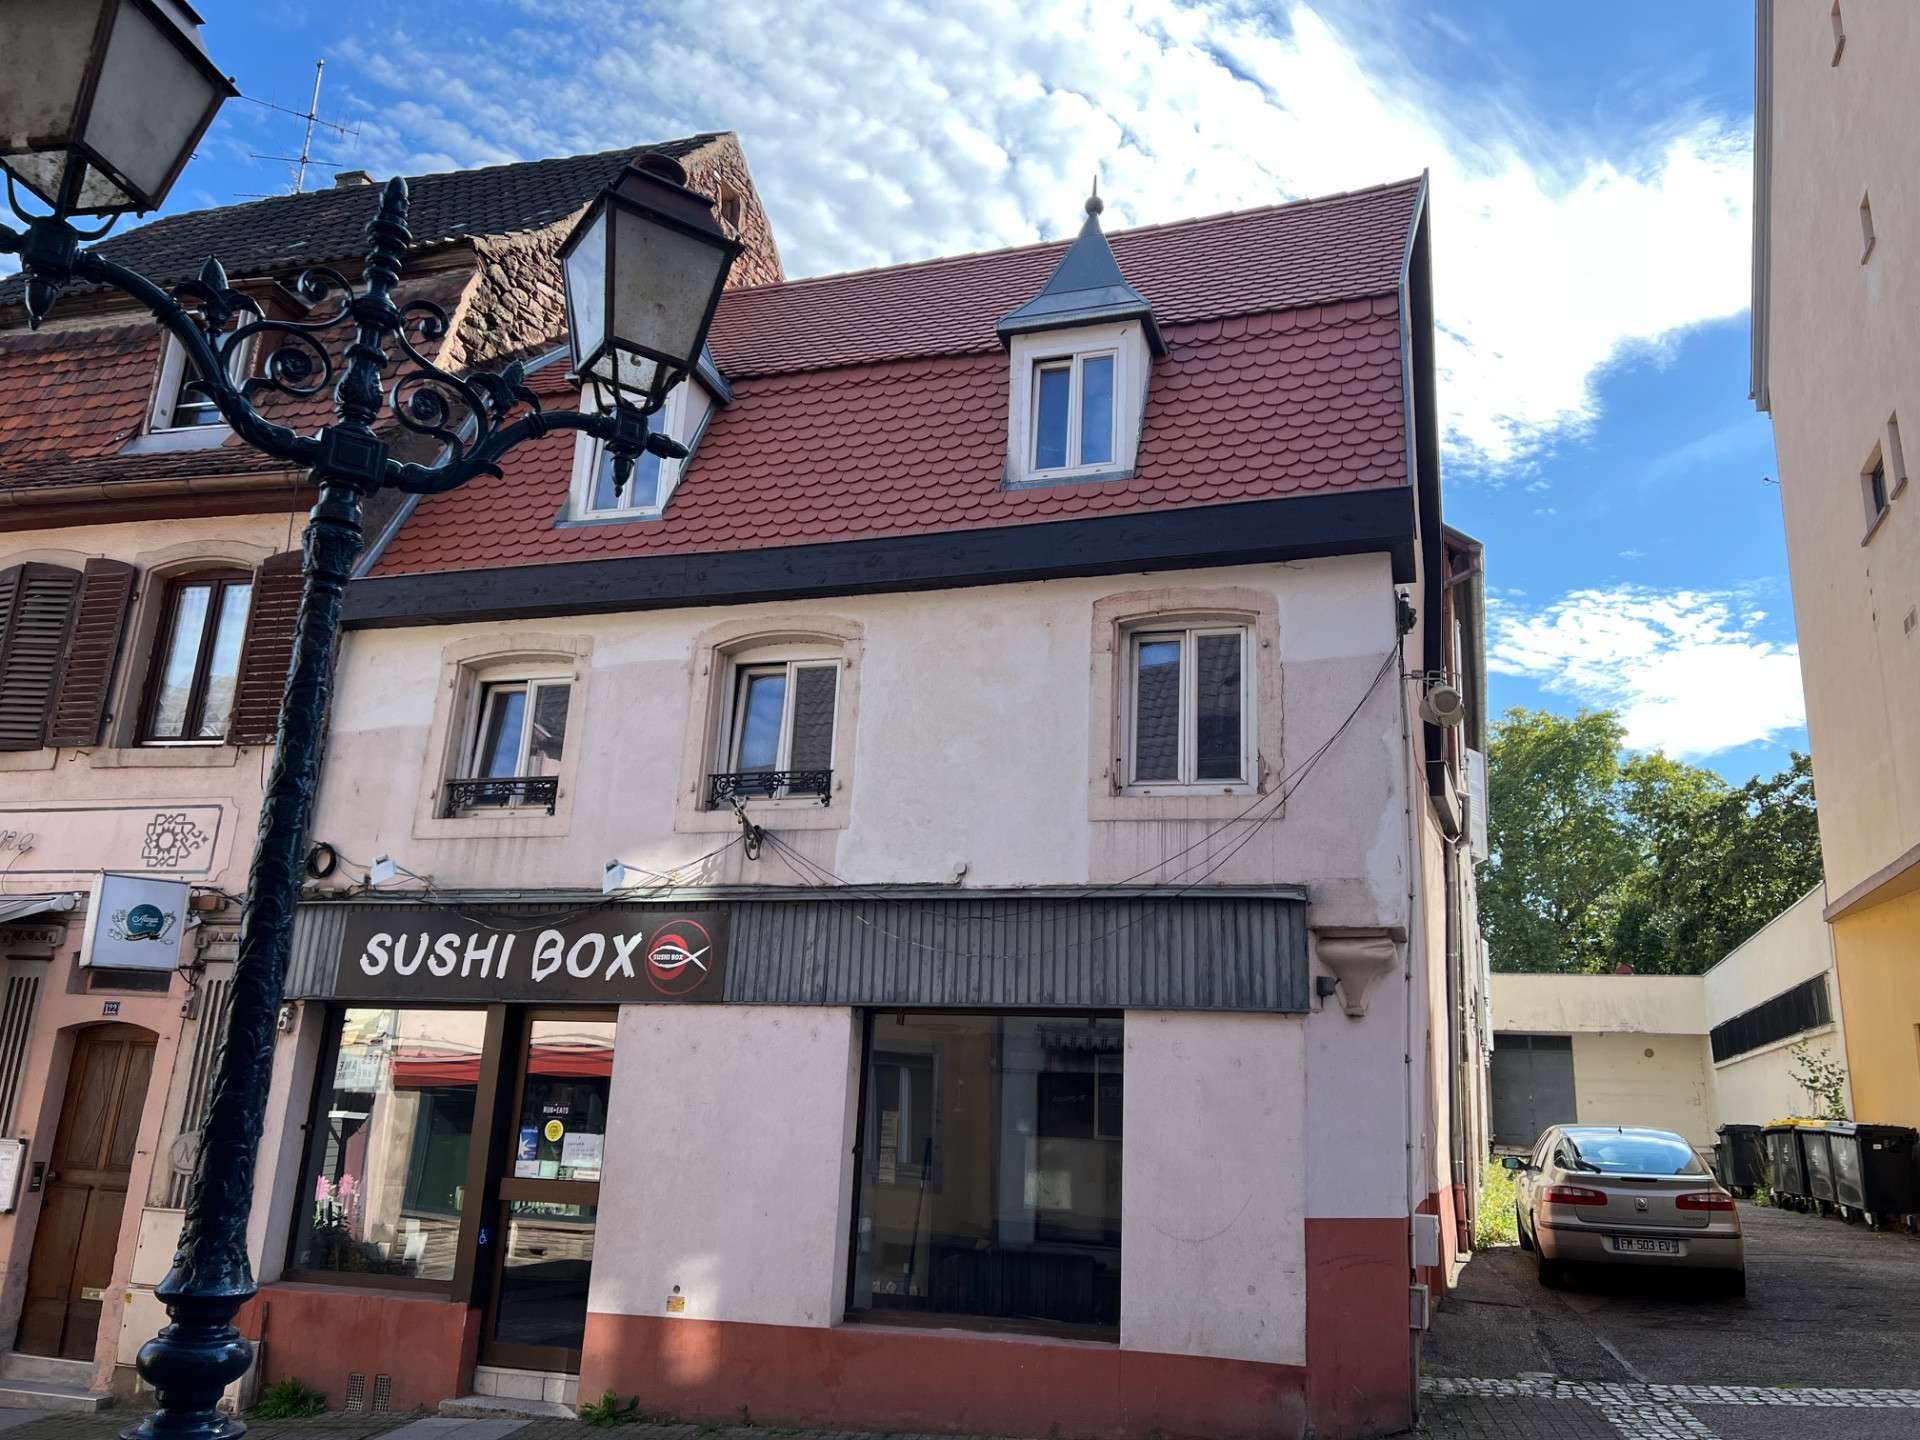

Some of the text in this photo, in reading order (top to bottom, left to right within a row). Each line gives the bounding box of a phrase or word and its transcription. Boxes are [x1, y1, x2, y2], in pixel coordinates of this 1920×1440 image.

[360, 929, 643, 982] SUSHI BOX
[652, 953, 685, 961] SUSHI BOX
